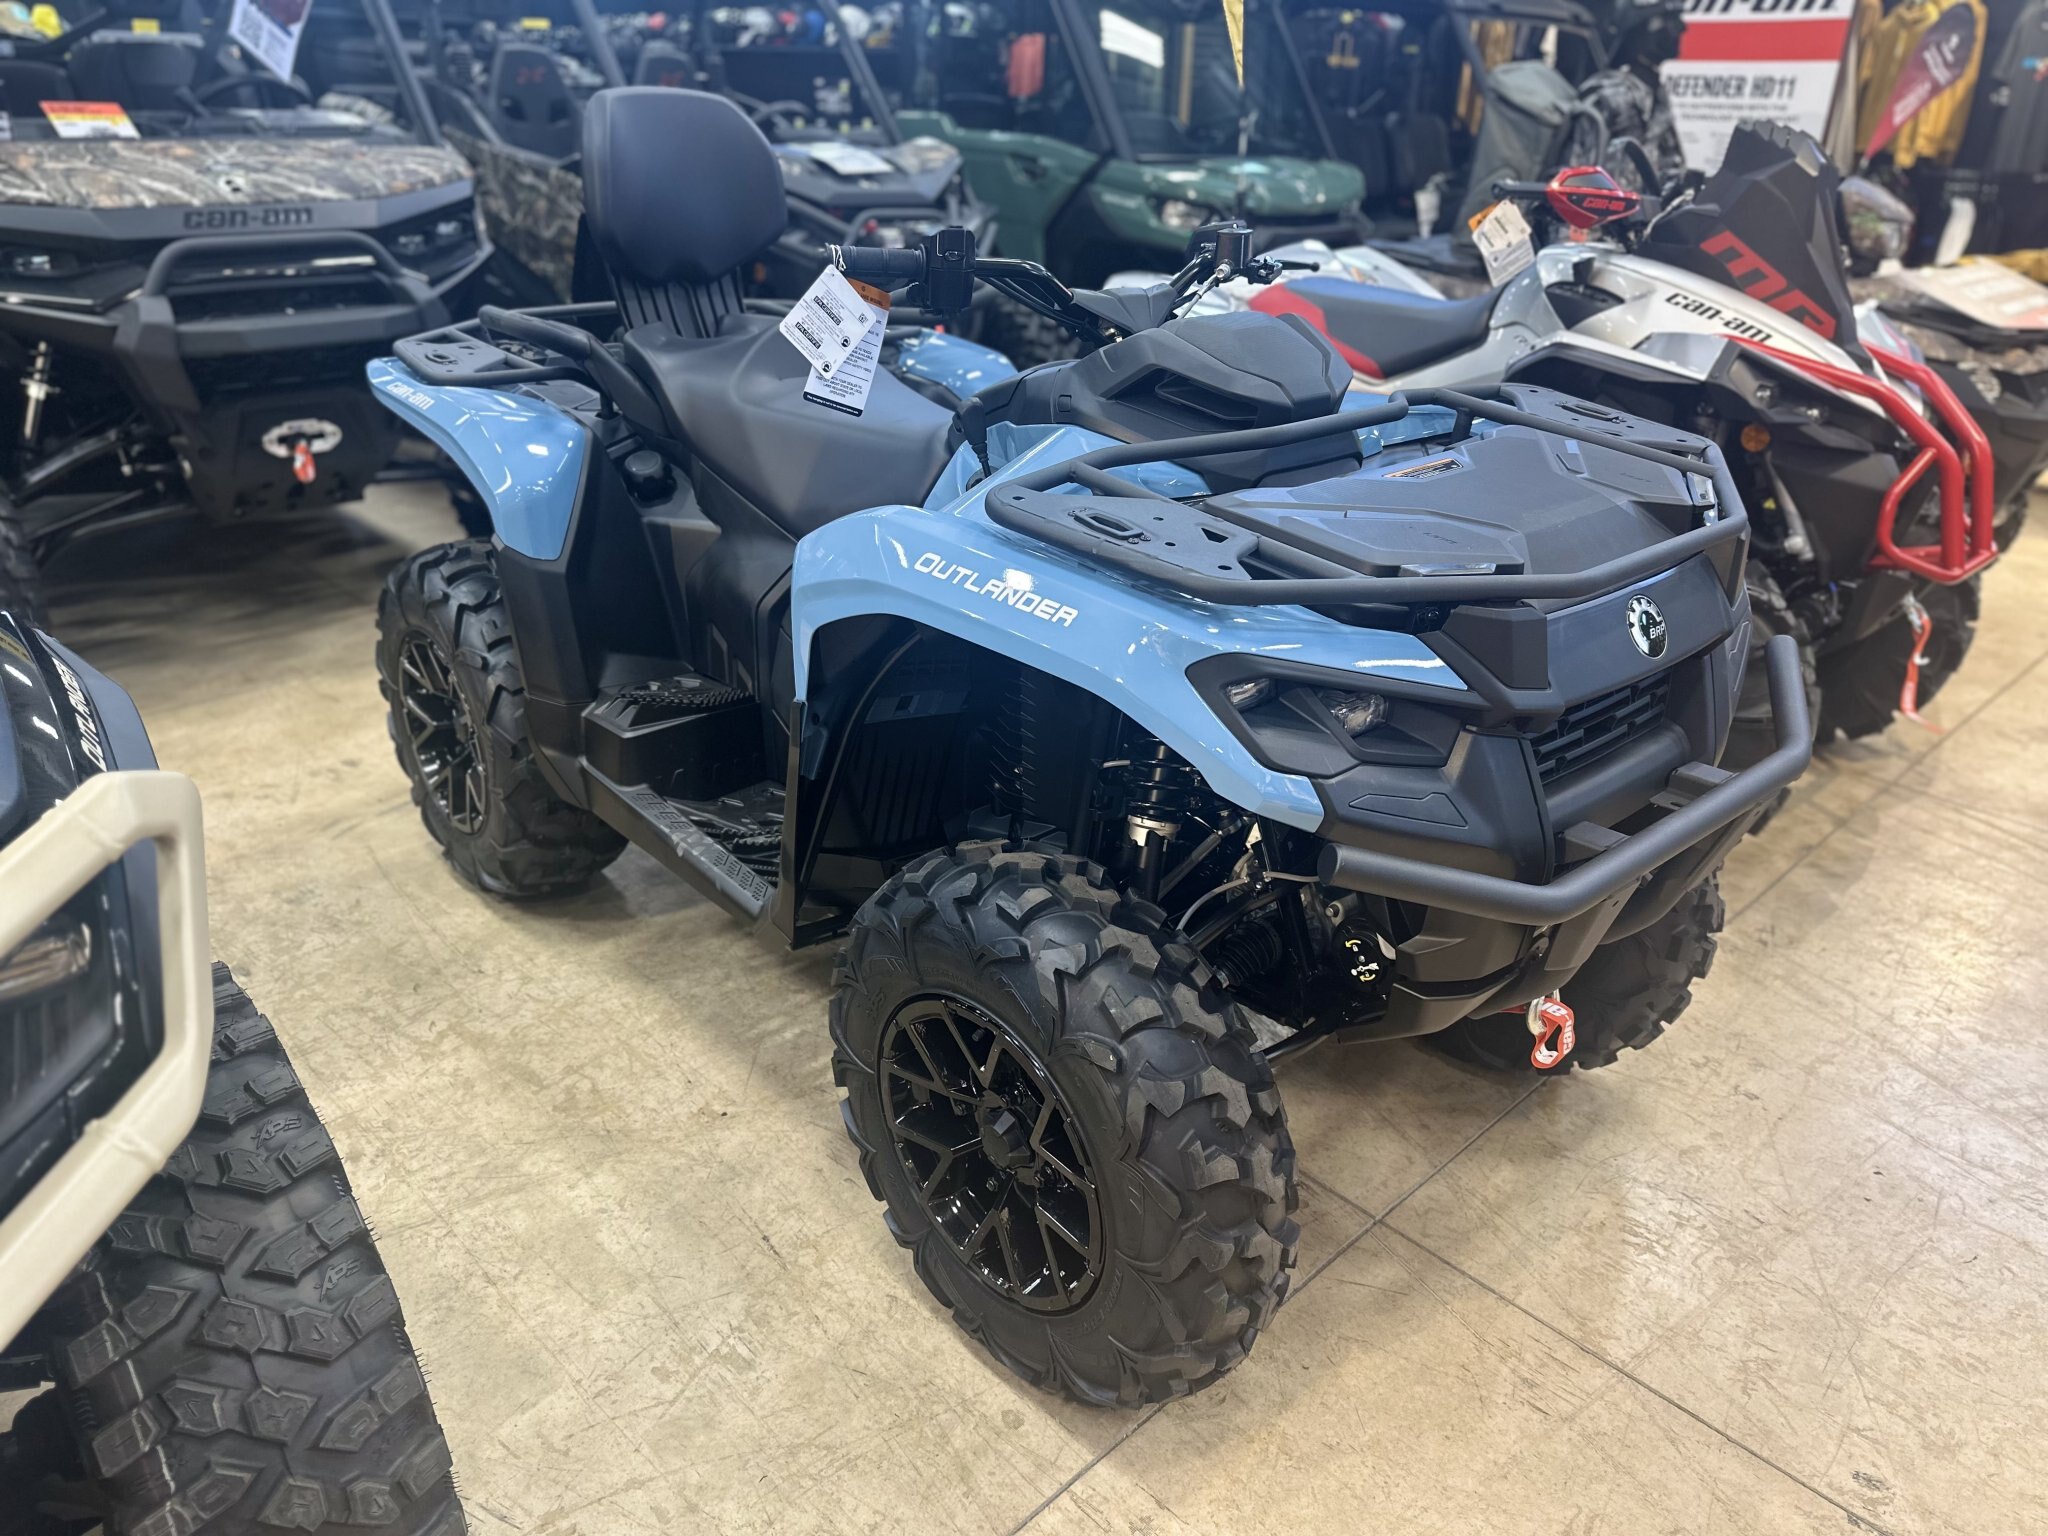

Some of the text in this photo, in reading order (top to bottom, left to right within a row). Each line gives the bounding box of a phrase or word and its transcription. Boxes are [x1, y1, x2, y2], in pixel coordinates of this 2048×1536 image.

[1751, 76, 1796, 98] HD11
[183, 206, 313, 230] can-am
[1665, 292, 1773, 343] can-am
[386, 381, 435, 410] can-am
[914, 552, 1079, 627] OUTLANDER
[1649, 623, 1666, 640] BRP
[52, 656, 108, 772] OUTLANDER
